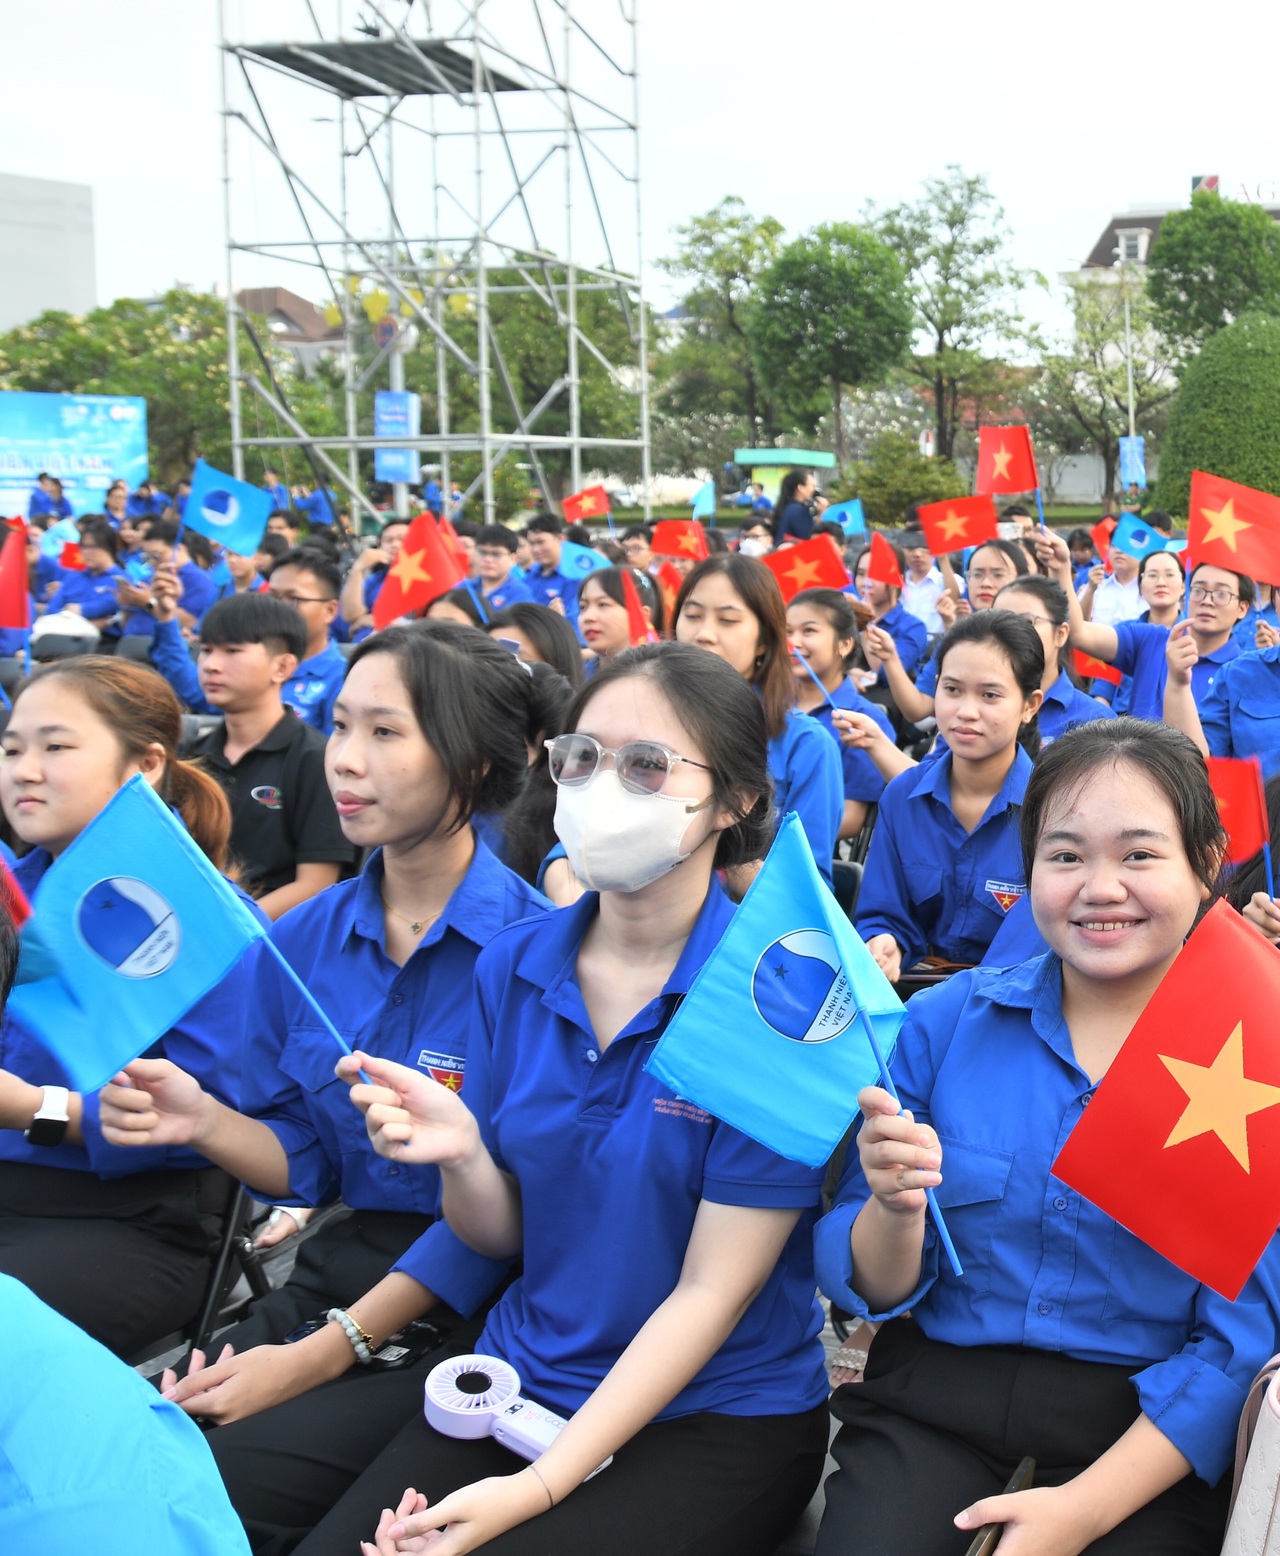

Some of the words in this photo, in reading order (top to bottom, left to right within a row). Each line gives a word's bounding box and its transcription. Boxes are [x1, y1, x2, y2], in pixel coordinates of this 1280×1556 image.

[818, 996, 840, 1027] THANH
[831, 1005, 847, 1026] VIỆT
[842, 987, 852, 1005] NA
